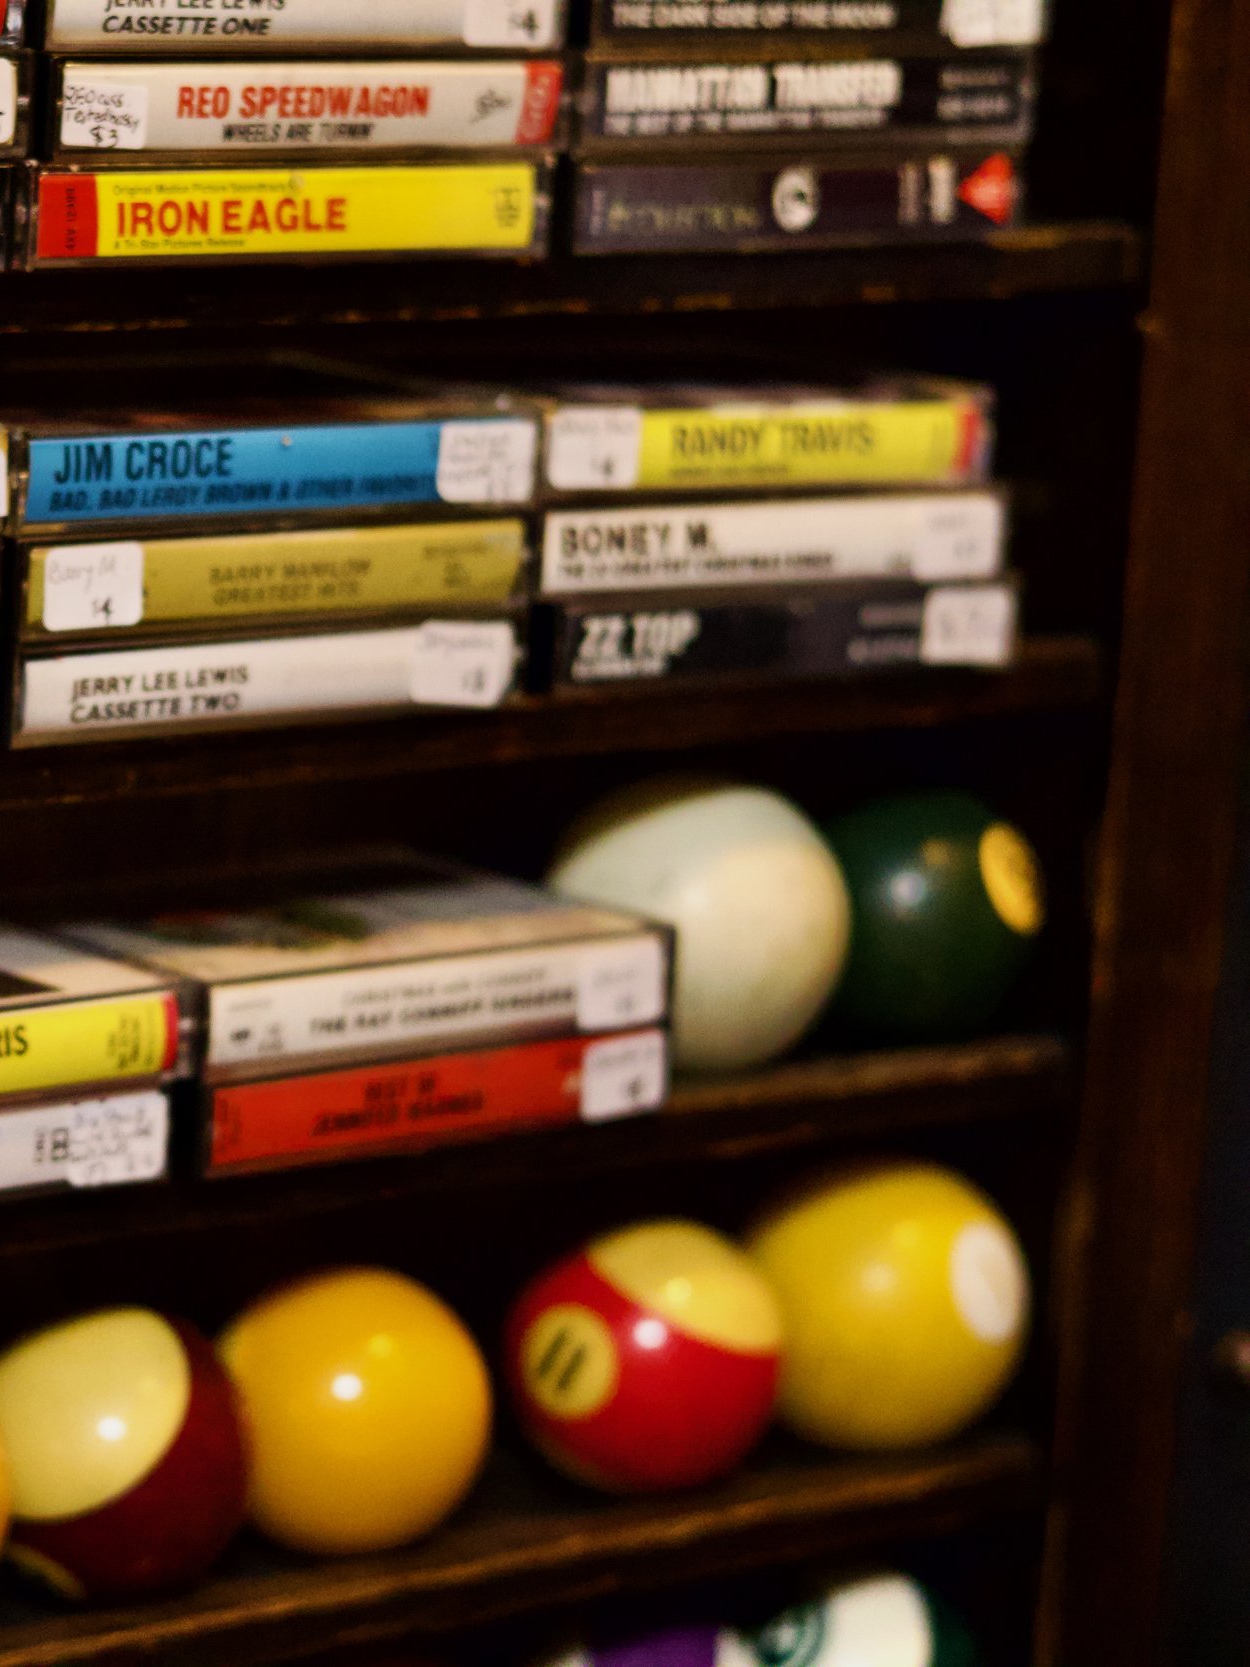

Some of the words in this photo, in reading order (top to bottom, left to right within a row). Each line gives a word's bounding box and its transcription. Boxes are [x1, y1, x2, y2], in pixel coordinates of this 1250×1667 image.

[102, 15, 217, 34] CASSETTE
[221, 17, 271, 35] ONE
[177, 86, 231, 119] REO
[238, 84, 431, 119] SPEEDWAGON
[117, 200, 209, 237] IRON
[221, 197, 347, 234] EAGLE
[670, 422, 765, 458] RANDY
[778, 421, 875, 456] TRAVIS
[53, 442, 113, 484] JIM
[125, 437, 233, 481] CROCE
[560, 521, 670, 558] BONEY
[71, 675, 136, 701] JERRY
[141, 670, 179, 693] LEE
[185, 664, 249, 689] LEWIS
[69, 696, 181, 724] CASSETTE
